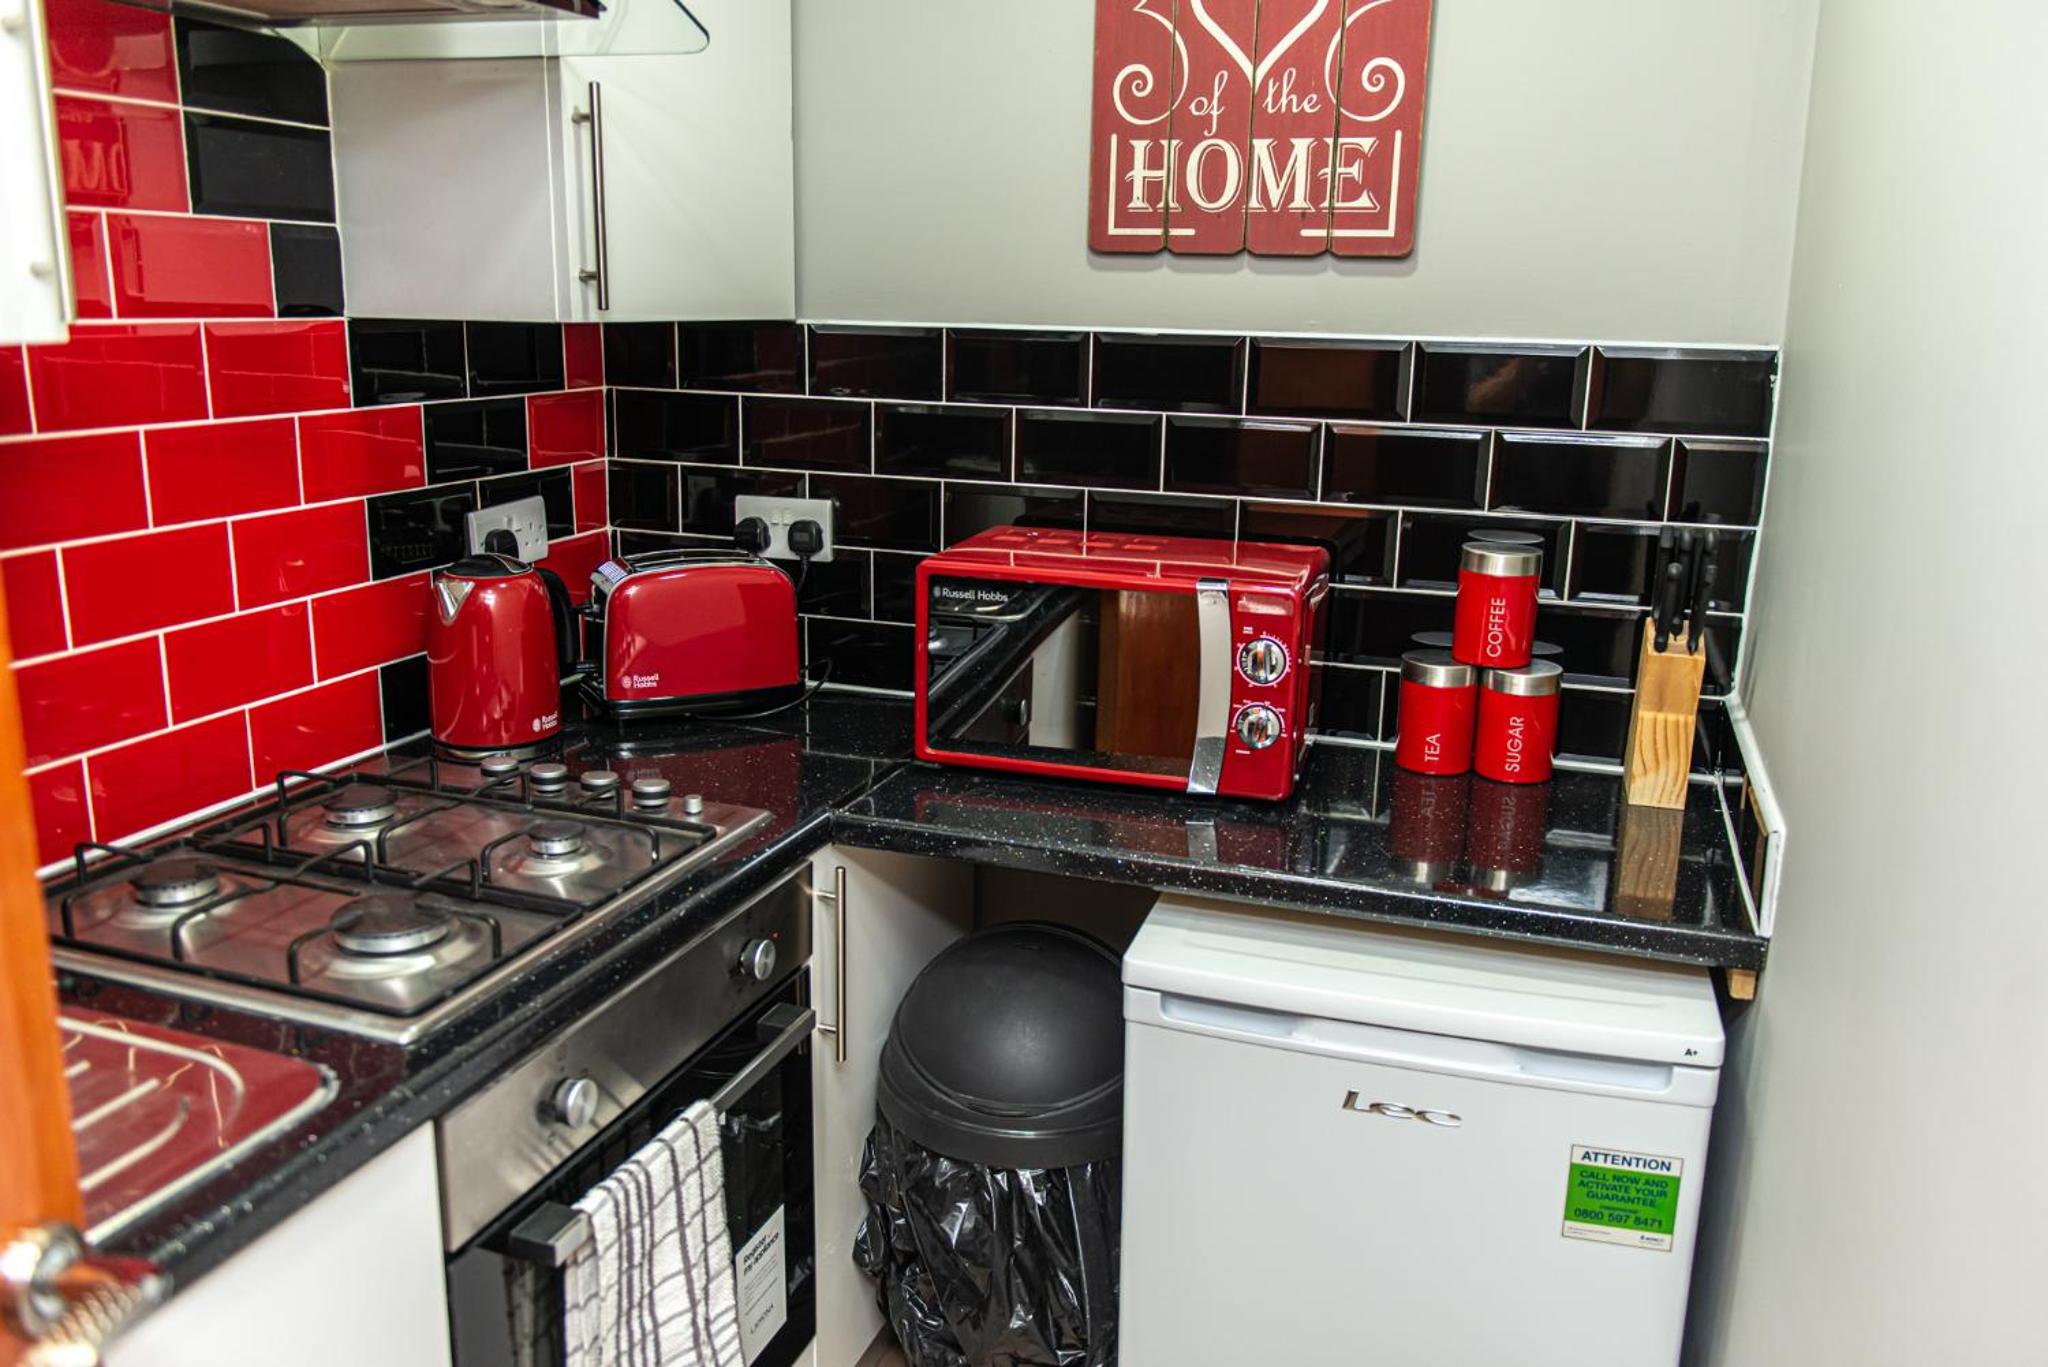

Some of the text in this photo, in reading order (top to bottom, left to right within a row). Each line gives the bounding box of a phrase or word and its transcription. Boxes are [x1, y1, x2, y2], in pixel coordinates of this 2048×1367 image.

[1189, 67, 1322, 136] of the
[1125, 137, 1381, 213] HOME
[942, 587, 1009, 602] Russell Hobbs
[1486, 597, 1506, 658] COFFEE
[633, 673, 659, 682] Russell
[1424, 733, 1441, 762] TEA
[1504, 715, 1525, 773] SUGAR
[1342, 1089, 1462, 1128] Lec
[1581, 1150, 1672, 1172] ATTENTION
[1578, 1180, 1669, 1199] ACTIVATE YOUR
[1580, 1169, 1669, 1190] CALL NOW AND
[1586, 1190, 1658, 1208] GUARANTEE
[1574, 1208, 1604, 1221] 0800
